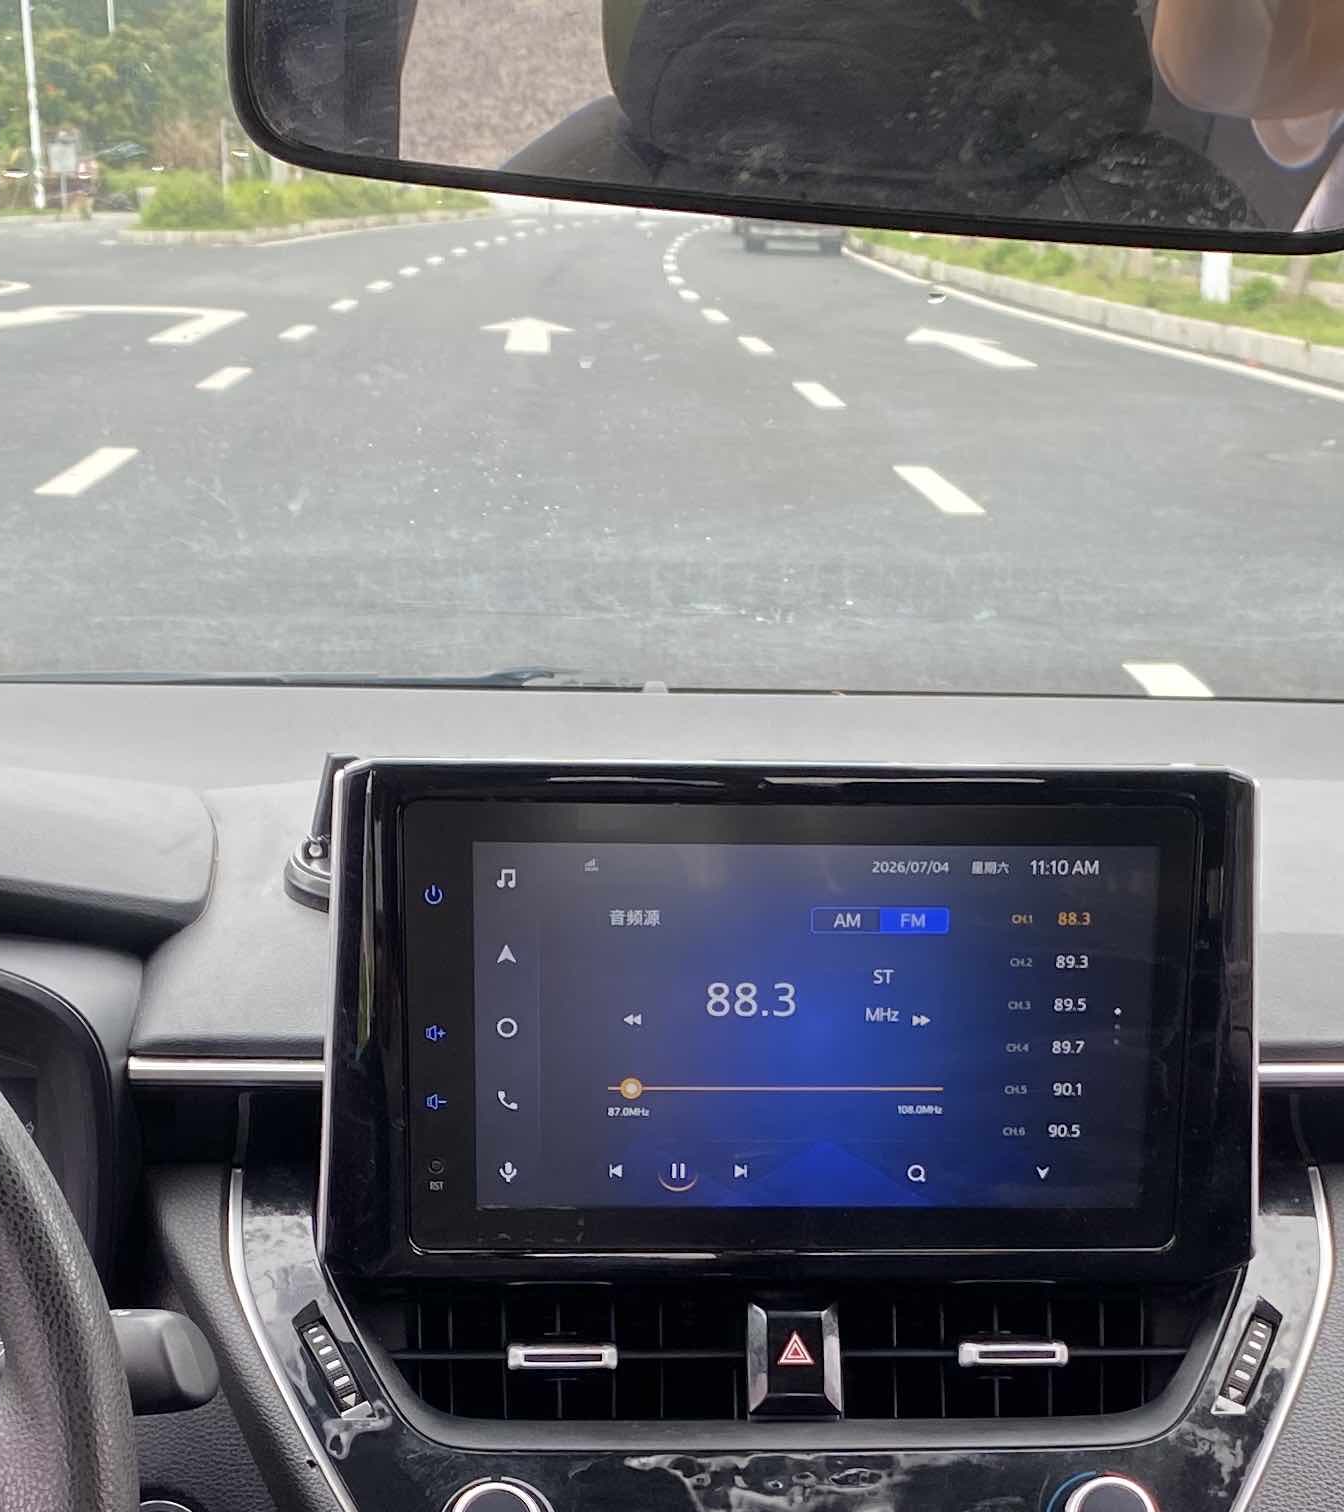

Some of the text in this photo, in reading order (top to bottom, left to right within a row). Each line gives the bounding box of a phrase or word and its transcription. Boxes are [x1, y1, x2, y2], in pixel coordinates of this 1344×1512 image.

[871, 861, 949, 875] 2026/07/04
[972, 861, 1009, 875] 星期六
[1030, 860, 1100, 875] 11:10 AM
[833, 913, 926, 928] AM FM
[1057, 912, 1090, 926] 88.3
[1055, 955, 1089, 970] 89.3
[873, 970, 894, 985] ST
[705, 982, 797, 1017] 88.3
[1053, 998, 1087, 1012] 89.5
[865, 1007, 900, 1023] MHz
[1052, 1040, 1085, 1054] 89.7
[1052, 1082, 1082, 1096] 90.1
[607, 1107, 650, 1118] 87.0MHz
[897, 1104, 943, 1116] 108.0MHz
[1048, 1124, 1081, 1138] 90.5
